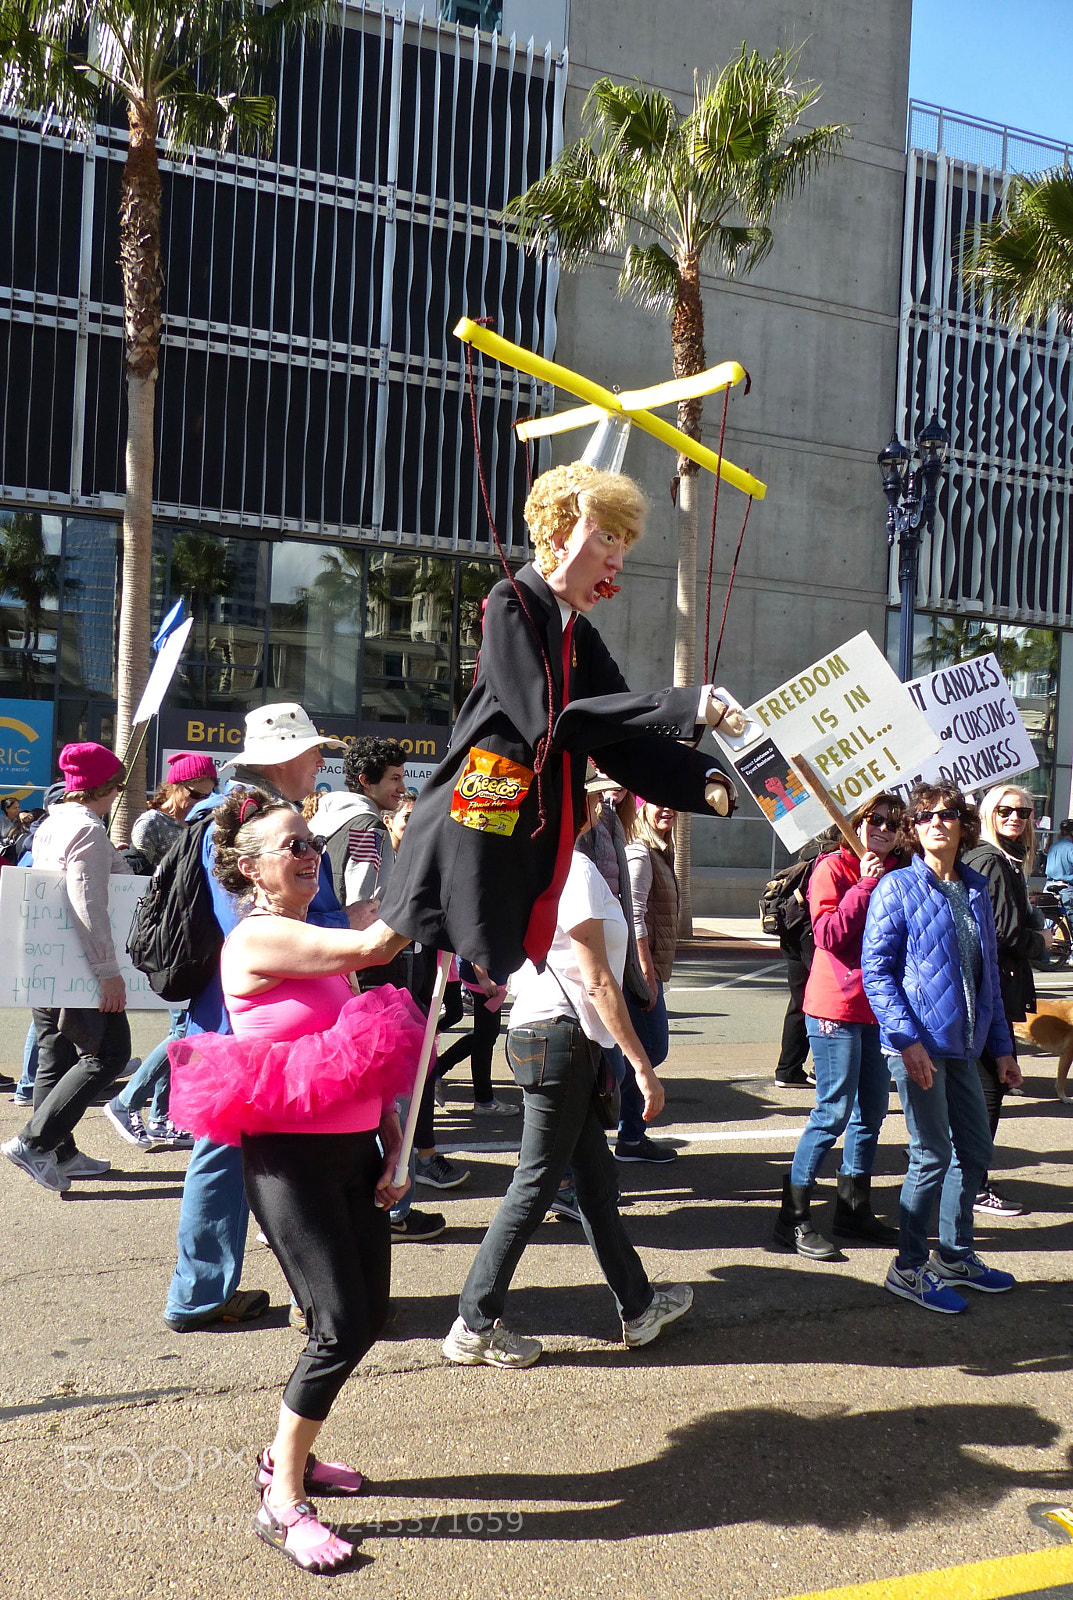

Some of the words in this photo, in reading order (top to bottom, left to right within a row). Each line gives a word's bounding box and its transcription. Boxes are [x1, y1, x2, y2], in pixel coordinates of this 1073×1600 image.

[756, 654, 850, 727] FREEDOM
[931, 657, 1000, 705] CANDLES
[811, 707, 839, 734] IS
[843, 684, 872, 713] IN
[953, 698, 1016, 744] CURSING
[0, 748, 31, 765] RIC
[814, 724, 893, 776] PERIL...
[938, 738, 1021, 785] DARKNESS
[461, 774, 520, 799] Cheetos
[827, 759, 886, 806] VOTE
[20, 904, 75, 930] Truth
[25, 943, 65, 966] Love
[13, 965, 56, 1004] Light
